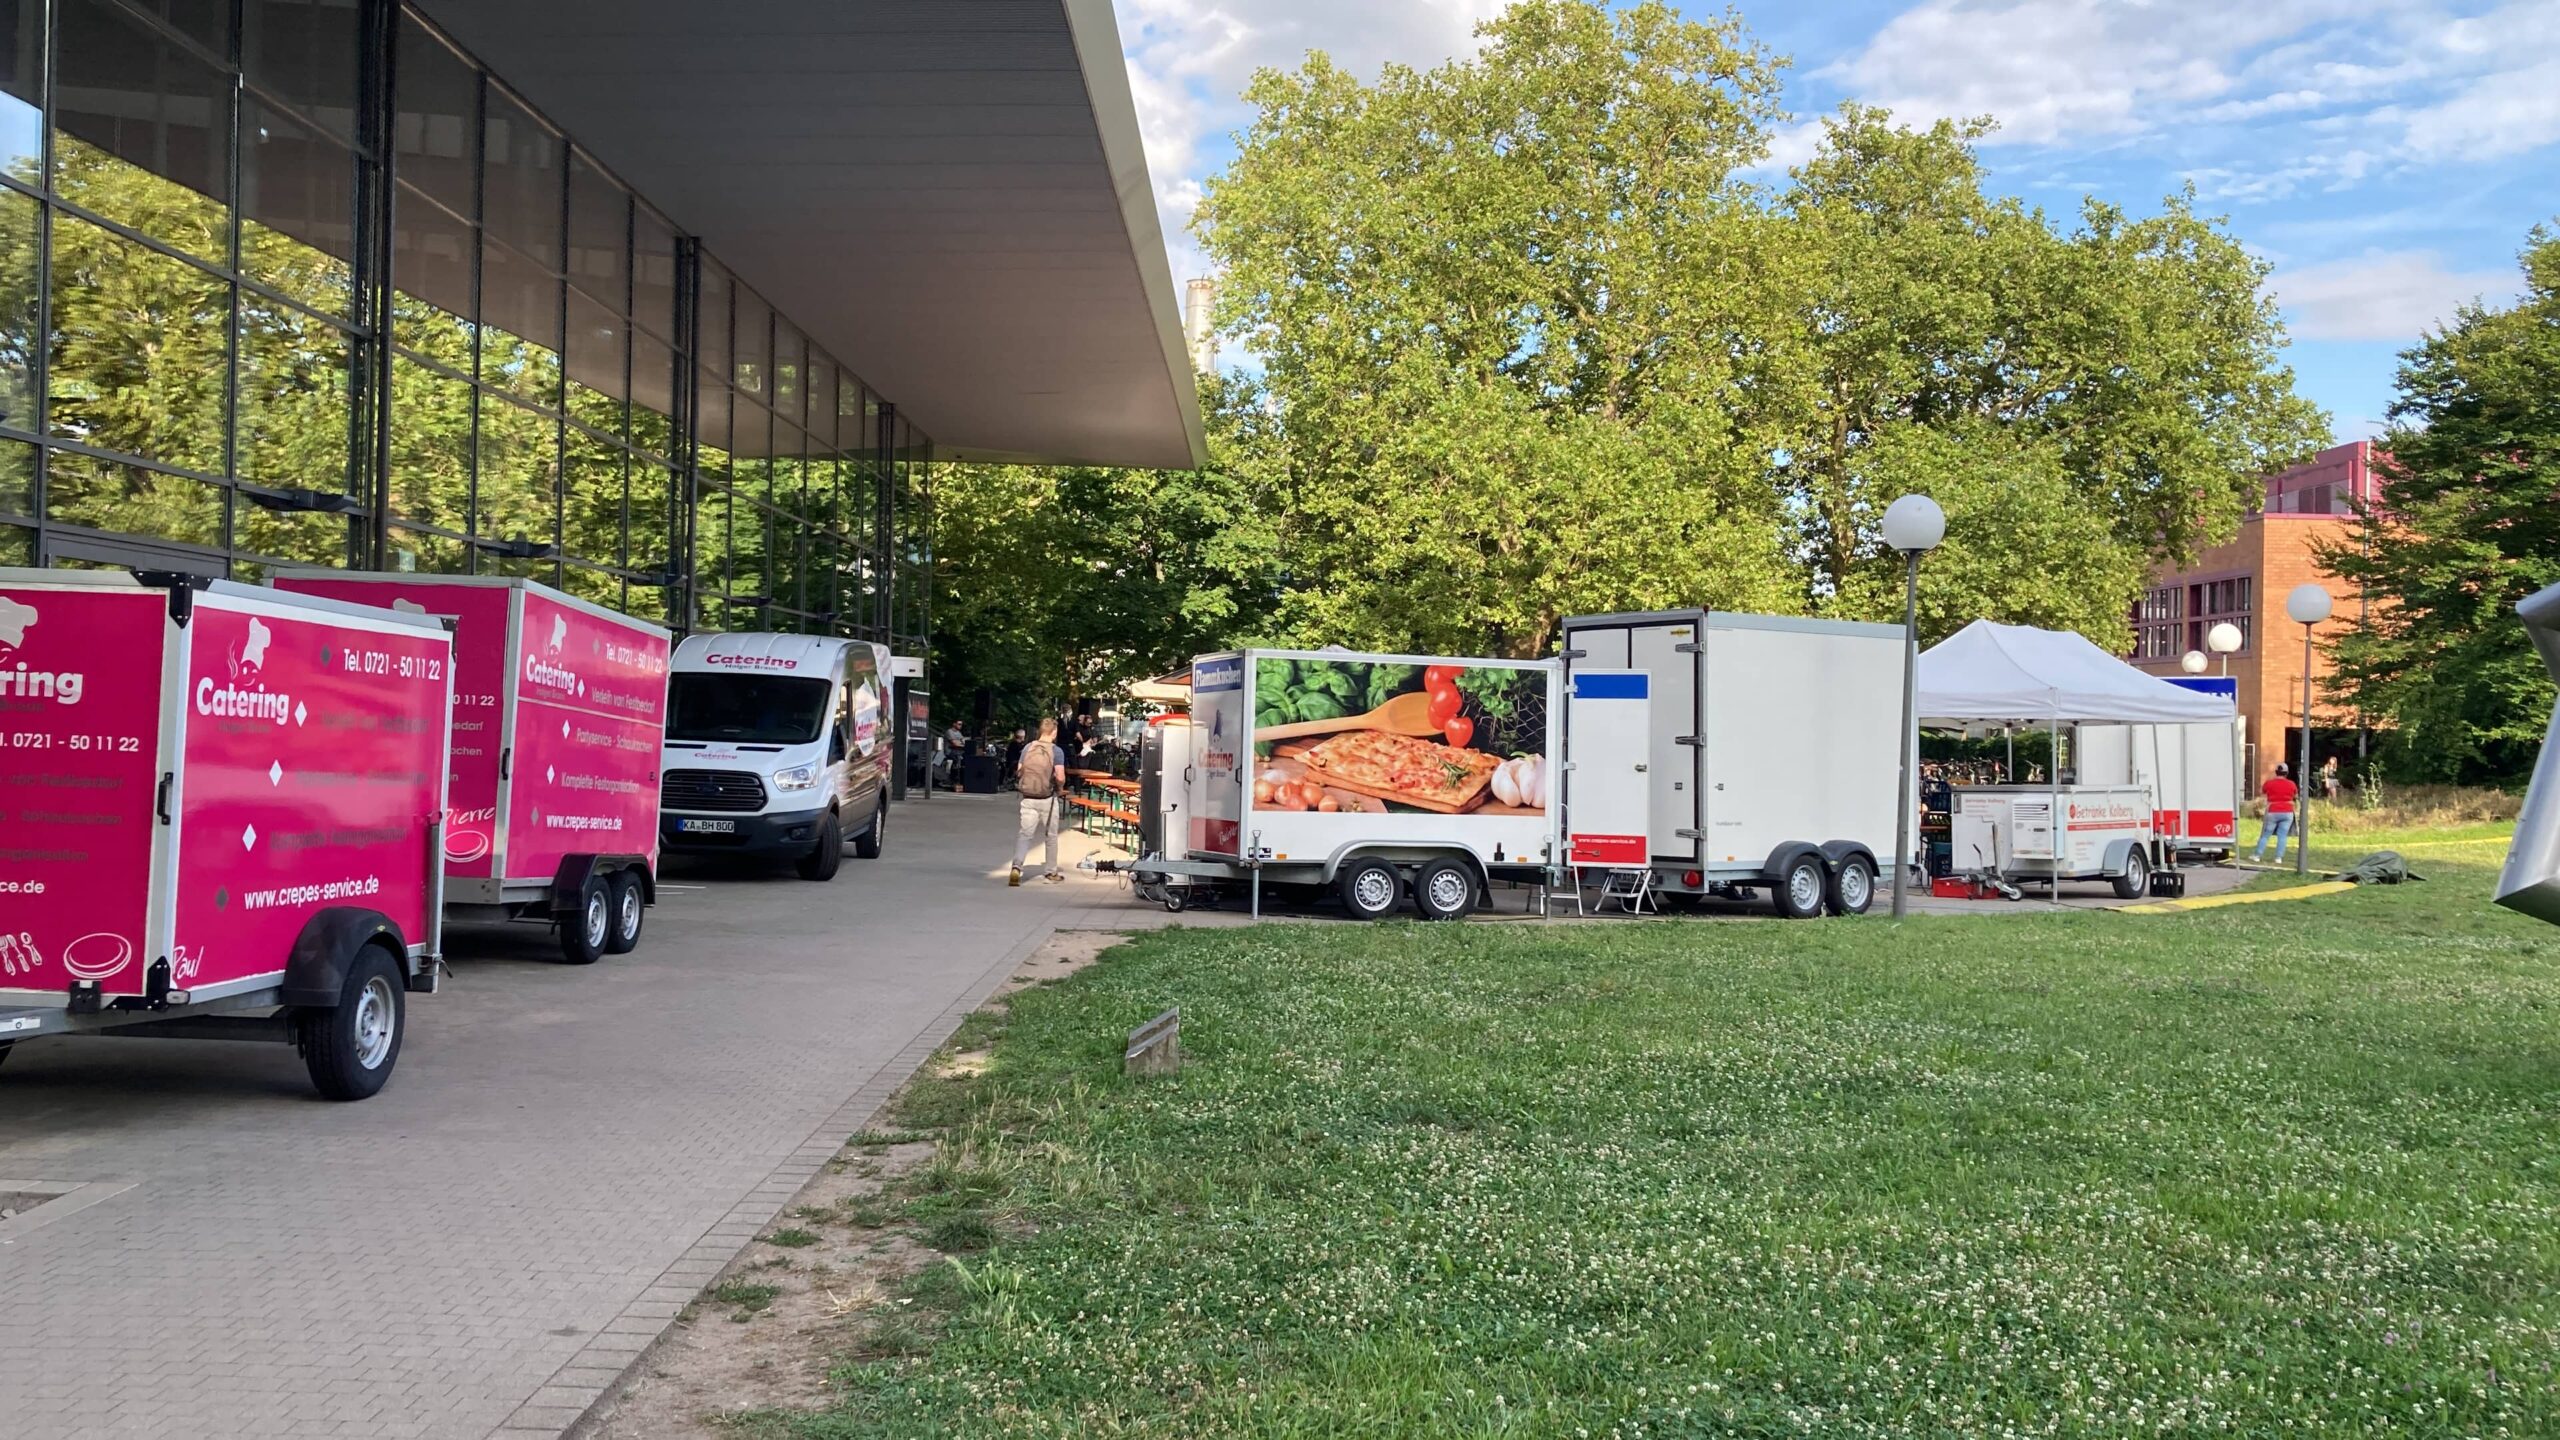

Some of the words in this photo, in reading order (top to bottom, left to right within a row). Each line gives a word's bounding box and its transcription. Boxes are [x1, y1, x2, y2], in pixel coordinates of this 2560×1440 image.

[344, 648, 361, 672] Tel.
[365, 651, 389, 675] 0721
[400, 656, 412, 677] 50
[416, 658, 425, 679] 11
[428, 659, 440, 680] 22
[618, 646, 632, 665] 0721
[638, 652, 646, 669] 50
[647, 655, 653, 671] 11
[655, 657, 663, 674] 22
[706, 654, 798, 669] Catering
[526, 654, 576, 695] Catering
[196, 677, 290, 725] Catering
[464, 694, 476, 705] 11
[480, 695, 495, 706] 22
[452, 721, 484, 731] edarf
[13, 733, 51, 748] 0721
[69, 735, 90, 750] 50
[97, 736, 112, 751] 11
[118, 737, 139, 752] 22
[546, 814, 622, 831] www.crepes-service.de
[684, 821, 696, 830] KA
[701, 821, 714, 831] BH
[716, 822, 734, 831] 800
[244, 874, 379, 909] www.crepes-service.de
[173, 945, 204, 980] Paul
